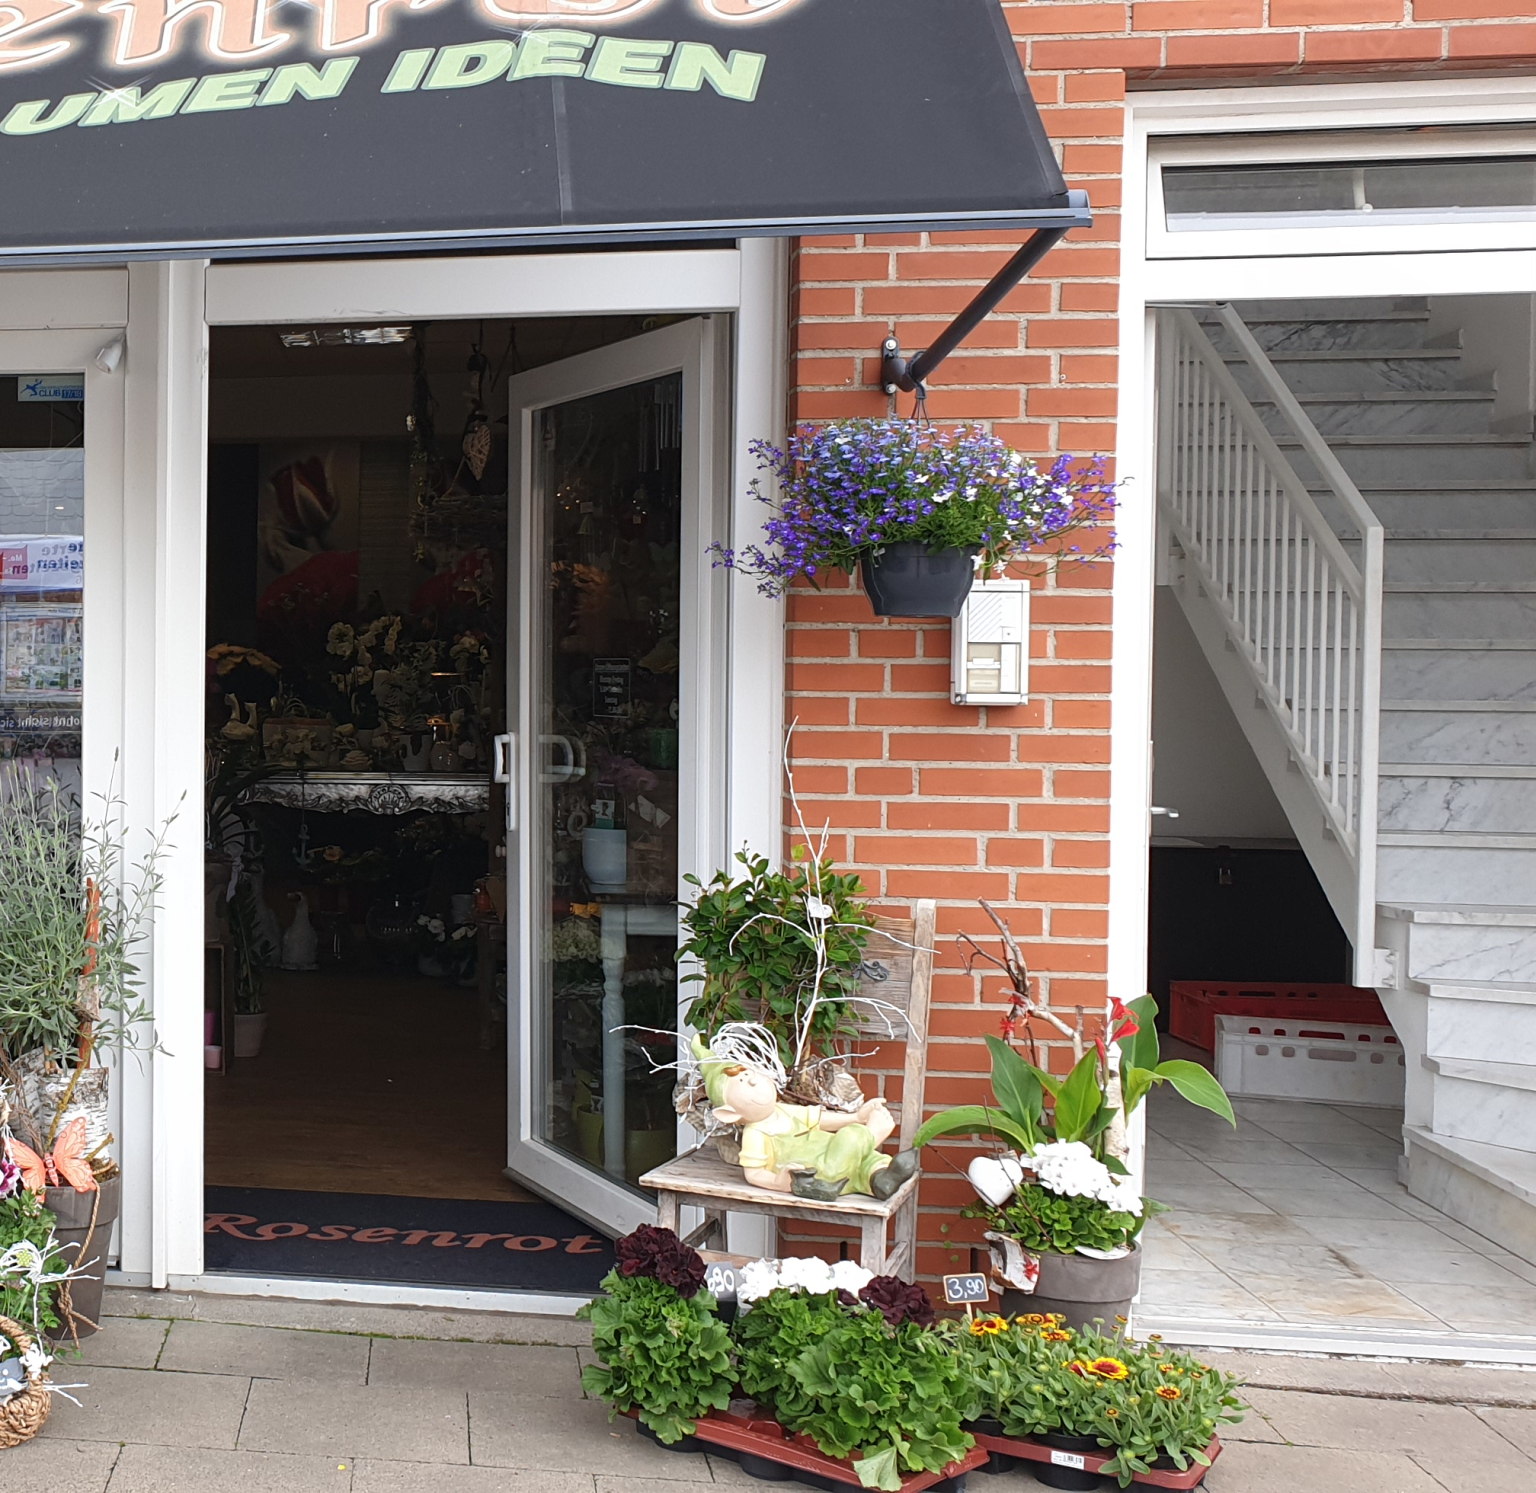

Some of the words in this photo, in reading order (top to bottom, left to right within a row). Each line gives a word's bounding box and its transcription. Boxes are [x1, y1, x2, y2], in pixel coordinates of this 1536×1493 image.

[380, 30, 766, 102] IDEEN
[204, 1212, 604, 1255] Rosenrot
[948, 1278, 985, 1299] 3,90
